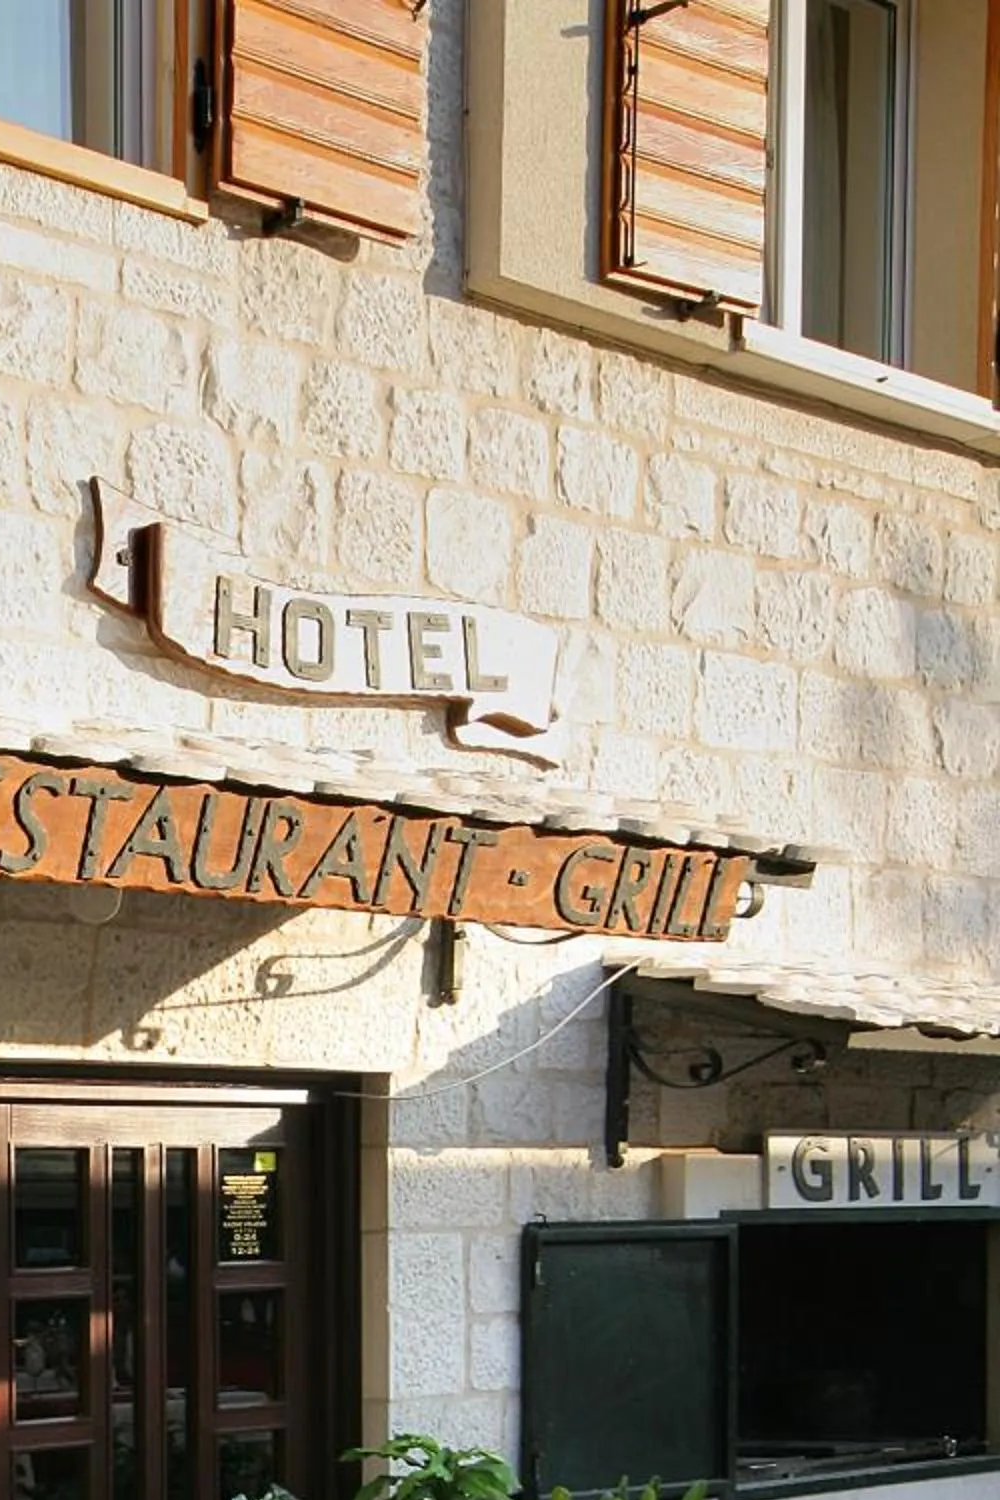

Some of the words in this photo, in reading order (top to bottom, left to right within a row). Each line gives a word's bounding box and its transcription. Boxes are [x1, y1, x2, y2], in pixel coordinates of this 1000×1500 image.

[213, 574, 509, 692] HOTEL
[553, 841, 733, 938] GRILL
[791, 1134, 982, 1203] GRILL
